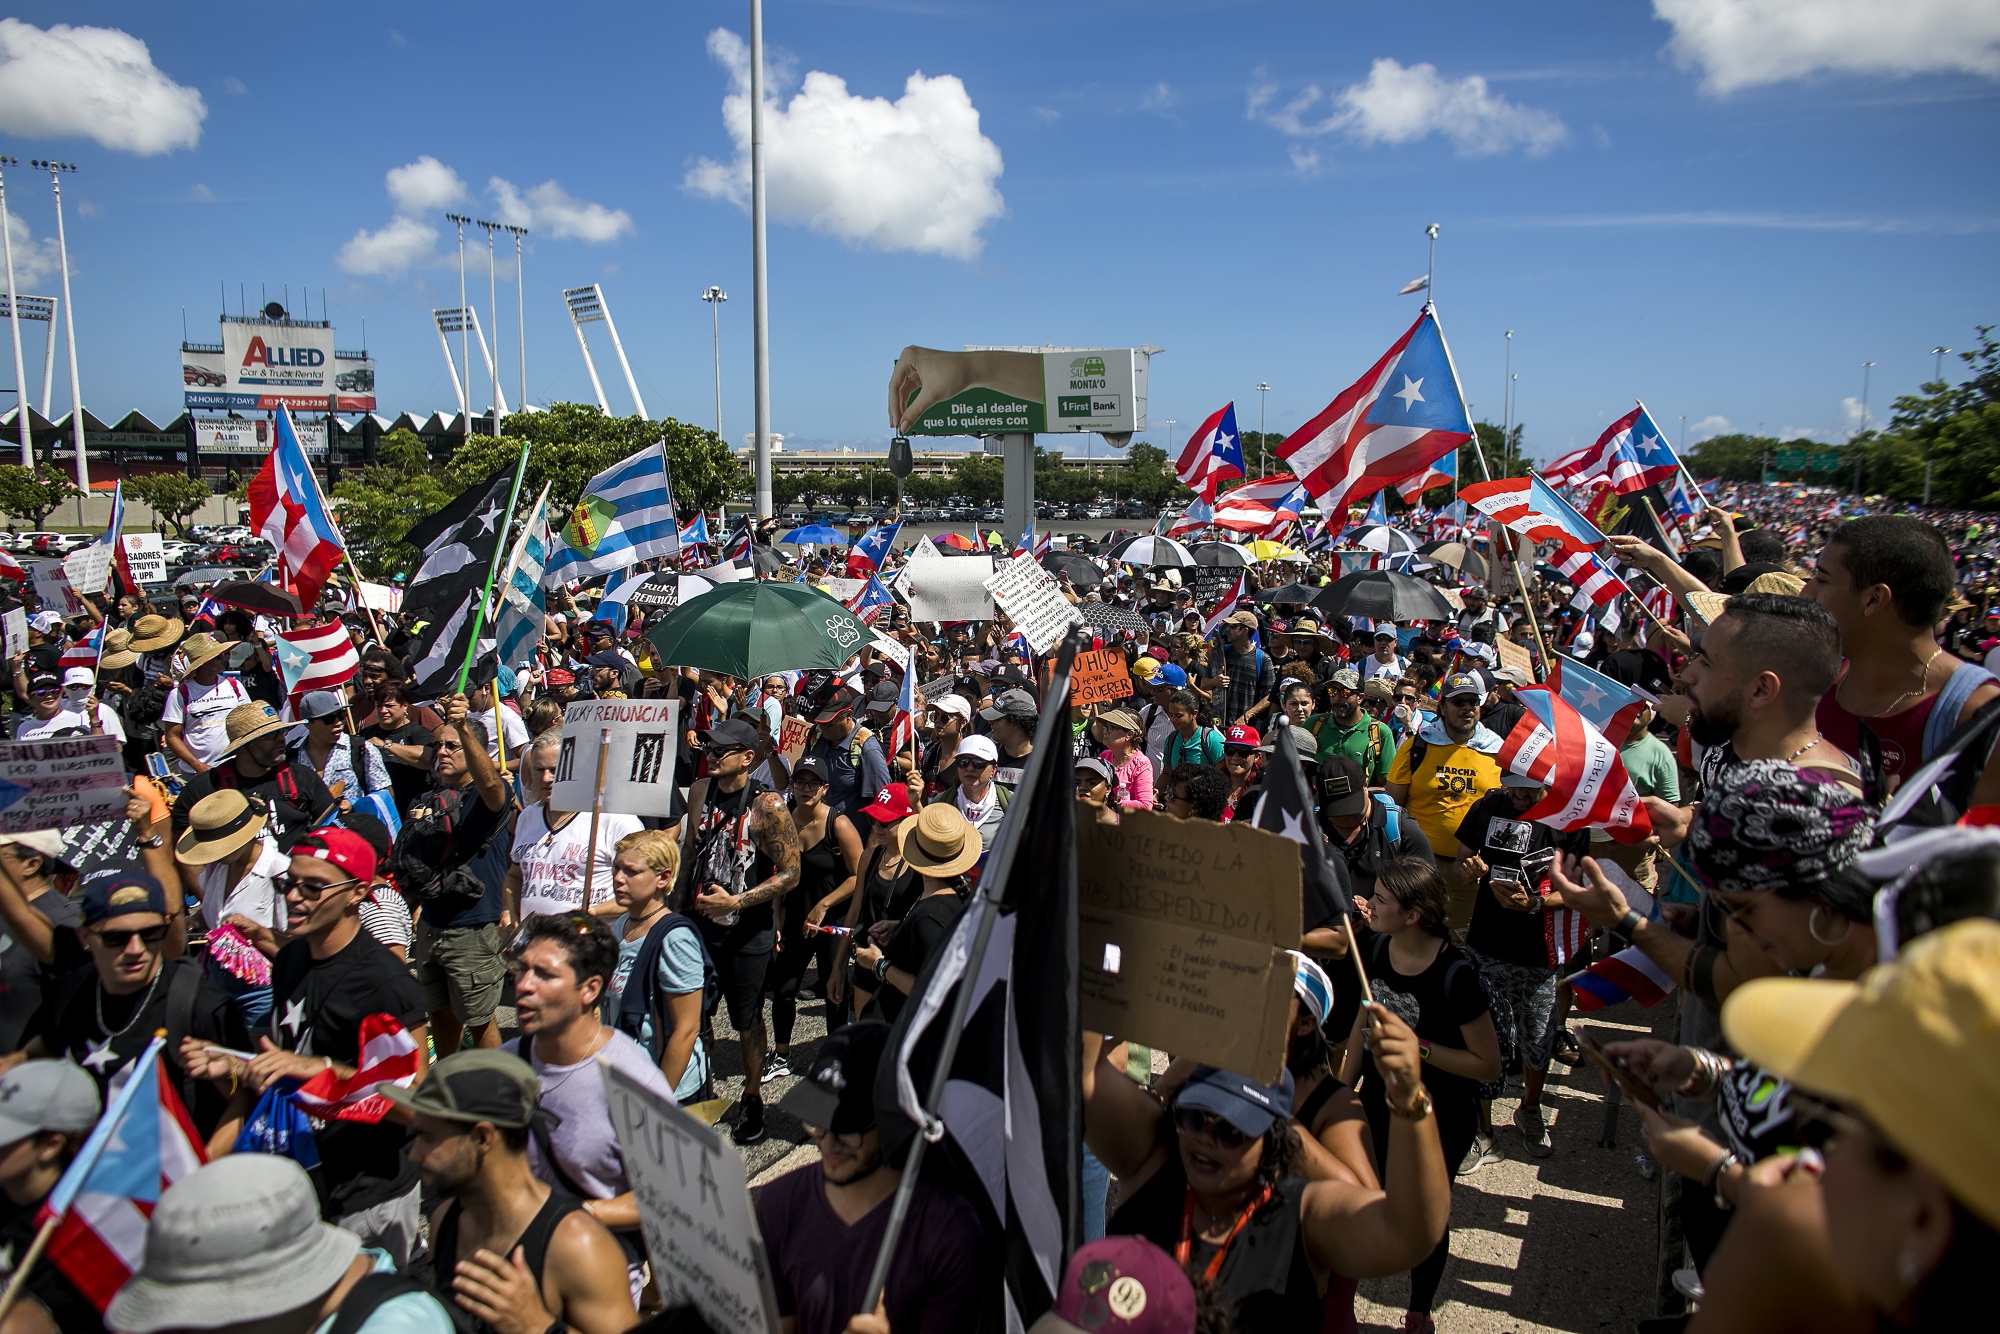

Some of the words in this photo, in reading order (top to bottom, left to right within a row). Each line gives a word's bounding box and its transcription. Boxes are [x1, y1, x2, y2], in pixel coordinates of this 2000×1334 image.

[242, 336, 325, 368] ALLIED
[240, 368, 260, 378] Car
[261, 370, 267, 378] &
[269, 369, 294, 378] Truck
[295, 370, 324, 379] Rental
[1070, 379, 1106, 390] MONTA'O
[187, 396, 198, 405] 24
[198, 396, 225, 405] HOURS
[231, 397, 236, 405] 7
[237, 397, 255, 406] DAYS
[274, 399, 328, 407] 77-726-7350
[1093, 401, 1116, 411] Bank
[951, 403, 974, 415] Dile
[976, 403, 988, 413] al
[989, 403, 1028, 413] dealer
[923, 418, 946, 428] que
[947, 416, 958, 426] lo
[960, 416, 1005, 428] quieres
[1006, 416, 1029, 426] con
[126, 551, 163, 561] SADORES,
[129, 561, 160, 571] STRUYEN
[139, 571, 154, 580] UPR
[1035, 576, 1053, 590] UPR
[1086, 650, 1118, 672] HIJO
[1082, 677, 1092, 685] te
[1082, 678, 1131, 700] QUERER
[564, 705, 593, 724] RICKY
[594, 705, 669, 723] RENUNCIA
[0, 740, 99, 762] ENUNCIA
[8, 764, 38, 776] POR
[1436, 766, 1476, 776] MARCHA
[67, 777, 93, 789] que
[1438, 775, 1477, 794] SOL
[24, 793, 79, 810] quieren
[561, 842, 590, 865] NO
[1131, 834, 1154, 857] TE
[1159, 840, 1203, 866] PIDO
[1213, 852, 1244, 872] LA
[613, 1089, 726, 1218] PUTA
